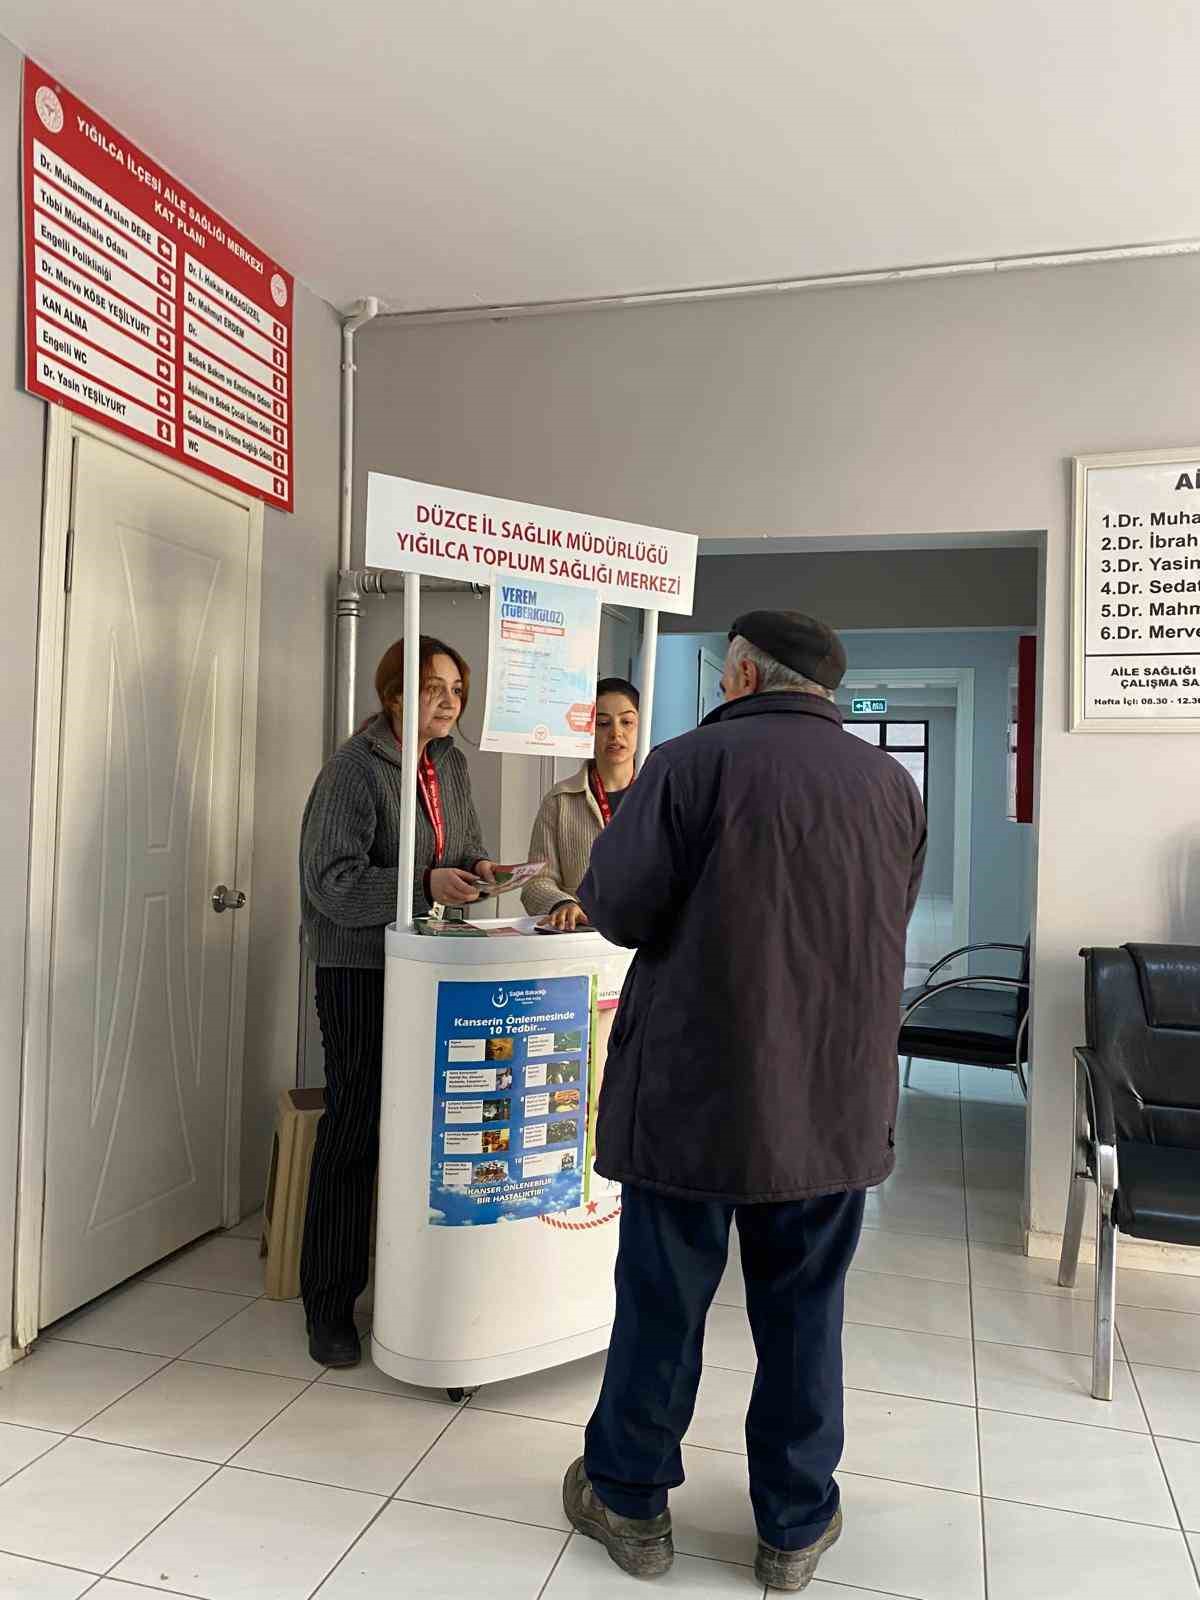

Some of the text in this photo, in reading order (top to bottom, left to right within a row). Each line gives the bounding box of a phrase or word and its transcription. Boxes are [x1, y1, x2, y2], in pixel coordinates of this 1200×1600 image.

[40, 154, 152, 244] Dr. Muhammed Arslan DERE
[77, 115, 264, 274] YIĞILCA İLÇESİ AİLE SAĞLIĞI MERKEZİ
[64, 205, 103, 243] Müdahale
[105, 233, 128, 260] Odası
[154, 201, 206, 249] KAT PLANI
[41, 225, 112, 281] Engelli Polikliniği
[188, 262, 197, 276] Dr.
[41, 260, 151, 337] Dr. Merve KÖSE YEŞİLYURT
[42, 294, 88, 332] KAN ALMA
[188, 291, 196, 305] Dr.
[224, 317, 245, 338] ERDEM
[188, 322, 197, 337] Dr.
[43, 331, 88, 365] Engelli WC
[43, 364, 127, 416] Dr. Yasin YEŞİLYURT
[188, 439, 199, 453] WC
[1102, 511, 1200, 528] 1.Dr. Muha
[416, 503, 669, 566] DÜZCE İL SAĞLIK MÜDÜRLÜĞÜ
[1101, 531, 1198, 550] 2.Dr. İbrah
[397, 531, 681, 596] YIĞILCA TOPLUM SAĞLIĞI MERKEZİ
[1101, 556, 1200, 573] 3.Dr. Yasin
[502, 586, 537, 606] VEREM
[1100, 581, 1143, 595] 4.Dr.
[1101, 603, 1142, 617] 5.Dr.
[1100, 626, 1142, 640] 6.Dr.
[1111, 665, 1196, 677] AİLE SAĞLIĞI
[1120, 678, 1178, 690] ÇALIŞMA
[454, 1011, 575, 1027] Kanserin Önlenmesinde
[489, 1023, 547, 1035] 10 Tedbir...
[468, 1186, 501, 1196] KANSER
